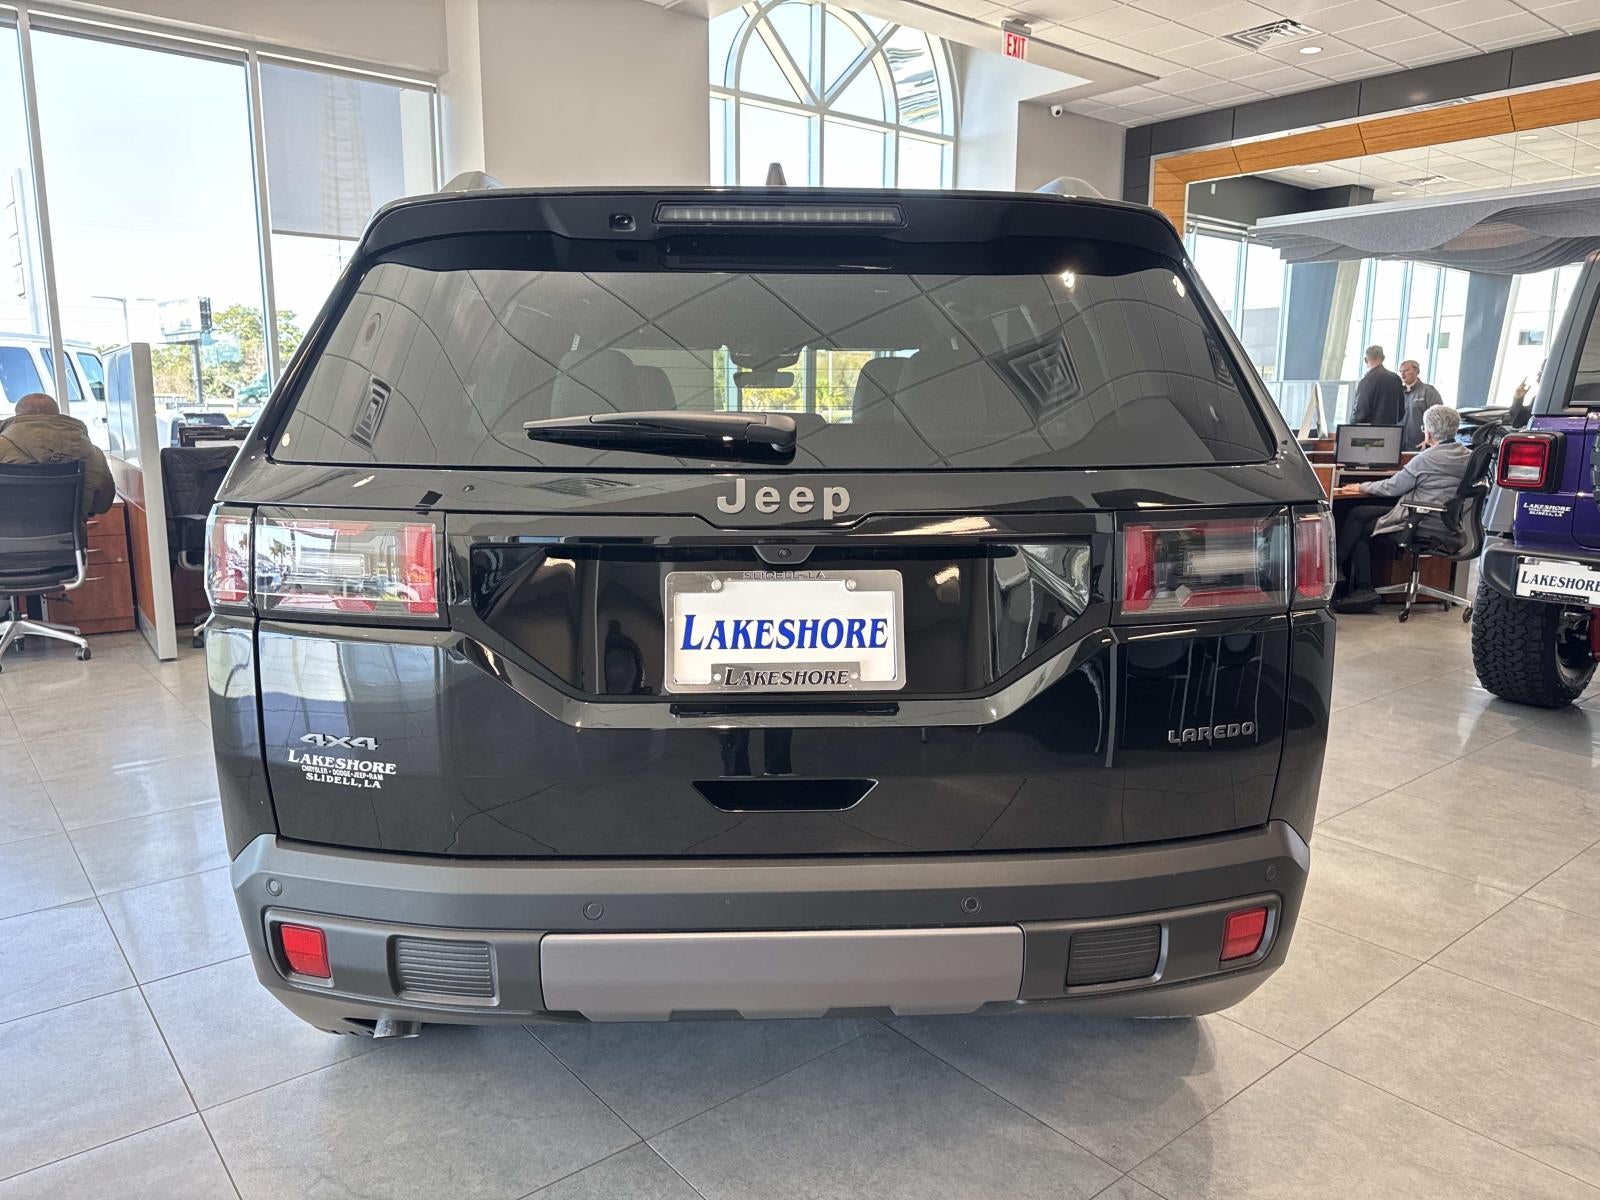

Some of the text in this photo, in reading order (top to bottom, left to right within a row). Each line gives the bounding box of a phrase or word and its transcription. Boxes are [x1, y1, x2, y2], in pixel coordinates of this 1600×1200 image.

[1006, 33, 1026, 59] EXIT
[716, 478, 850, 520] Jeep
[1523, 502, 1572, 512] LAKESHORE
[680, 614, 889, 650] LAKESHORE
[724, 667, 849, 686] LAKESHORE
[1168, 721, 1255, 743] LAREDO
[287, 749, 397, 775] LAKESHORE
[306, 772, 381, 789] SLIDELL, LA
